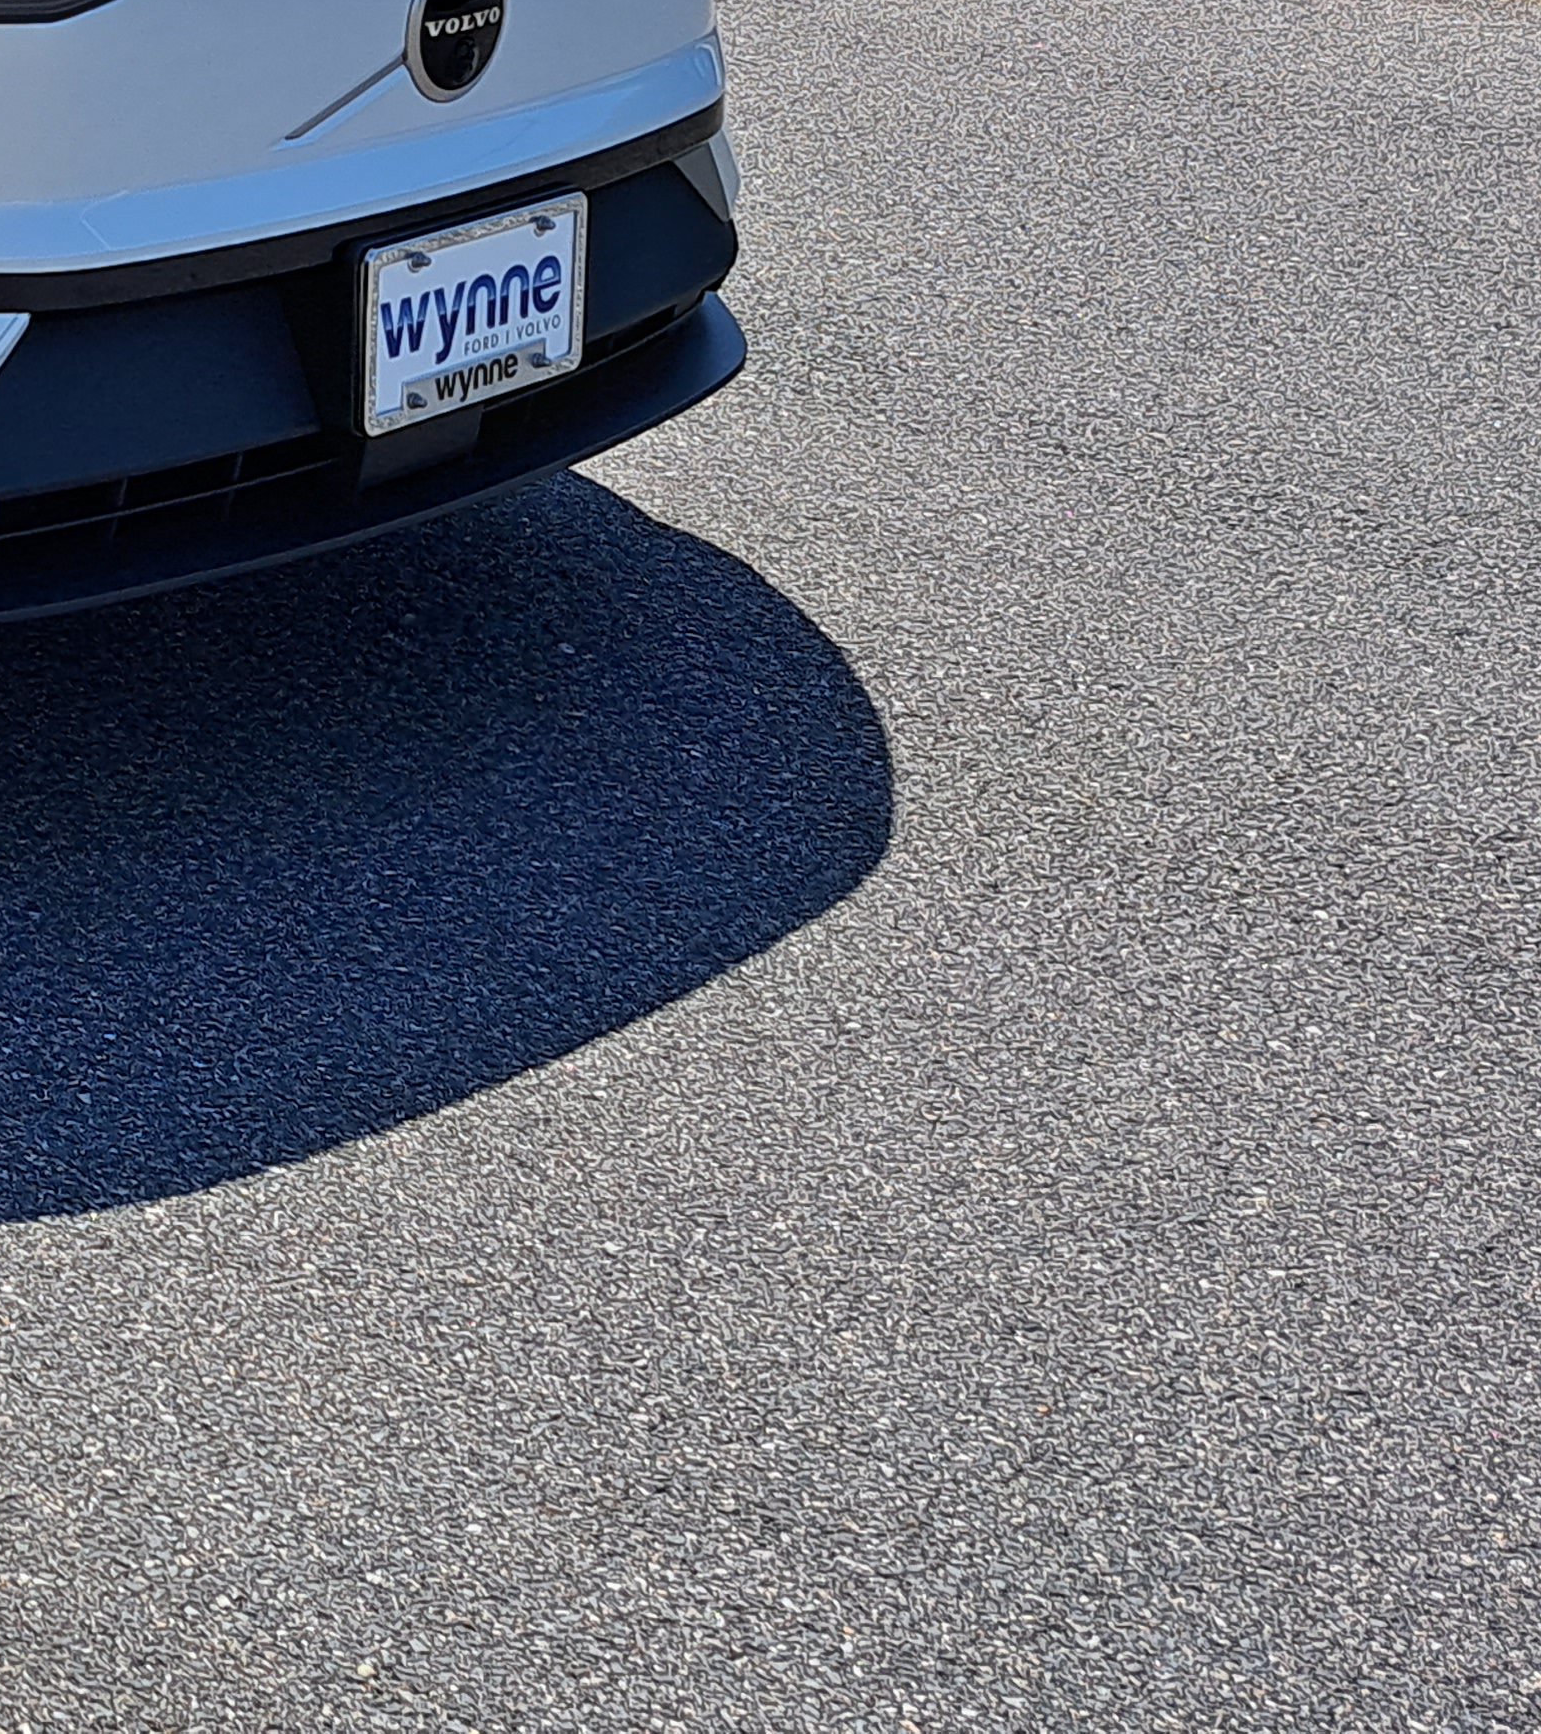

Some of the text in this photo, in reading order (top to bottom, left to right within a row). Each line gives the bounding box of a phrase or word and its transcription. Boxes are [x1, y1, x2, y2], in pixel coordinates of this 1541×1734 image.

[424, 6, 500, 37] VOLVO
[381, 255, 561, 364] wynne
[464, 333, 499, 355] FORD
[517, 314, 561, 339] VOLVO
[435, 353, 518, 402] wynne
